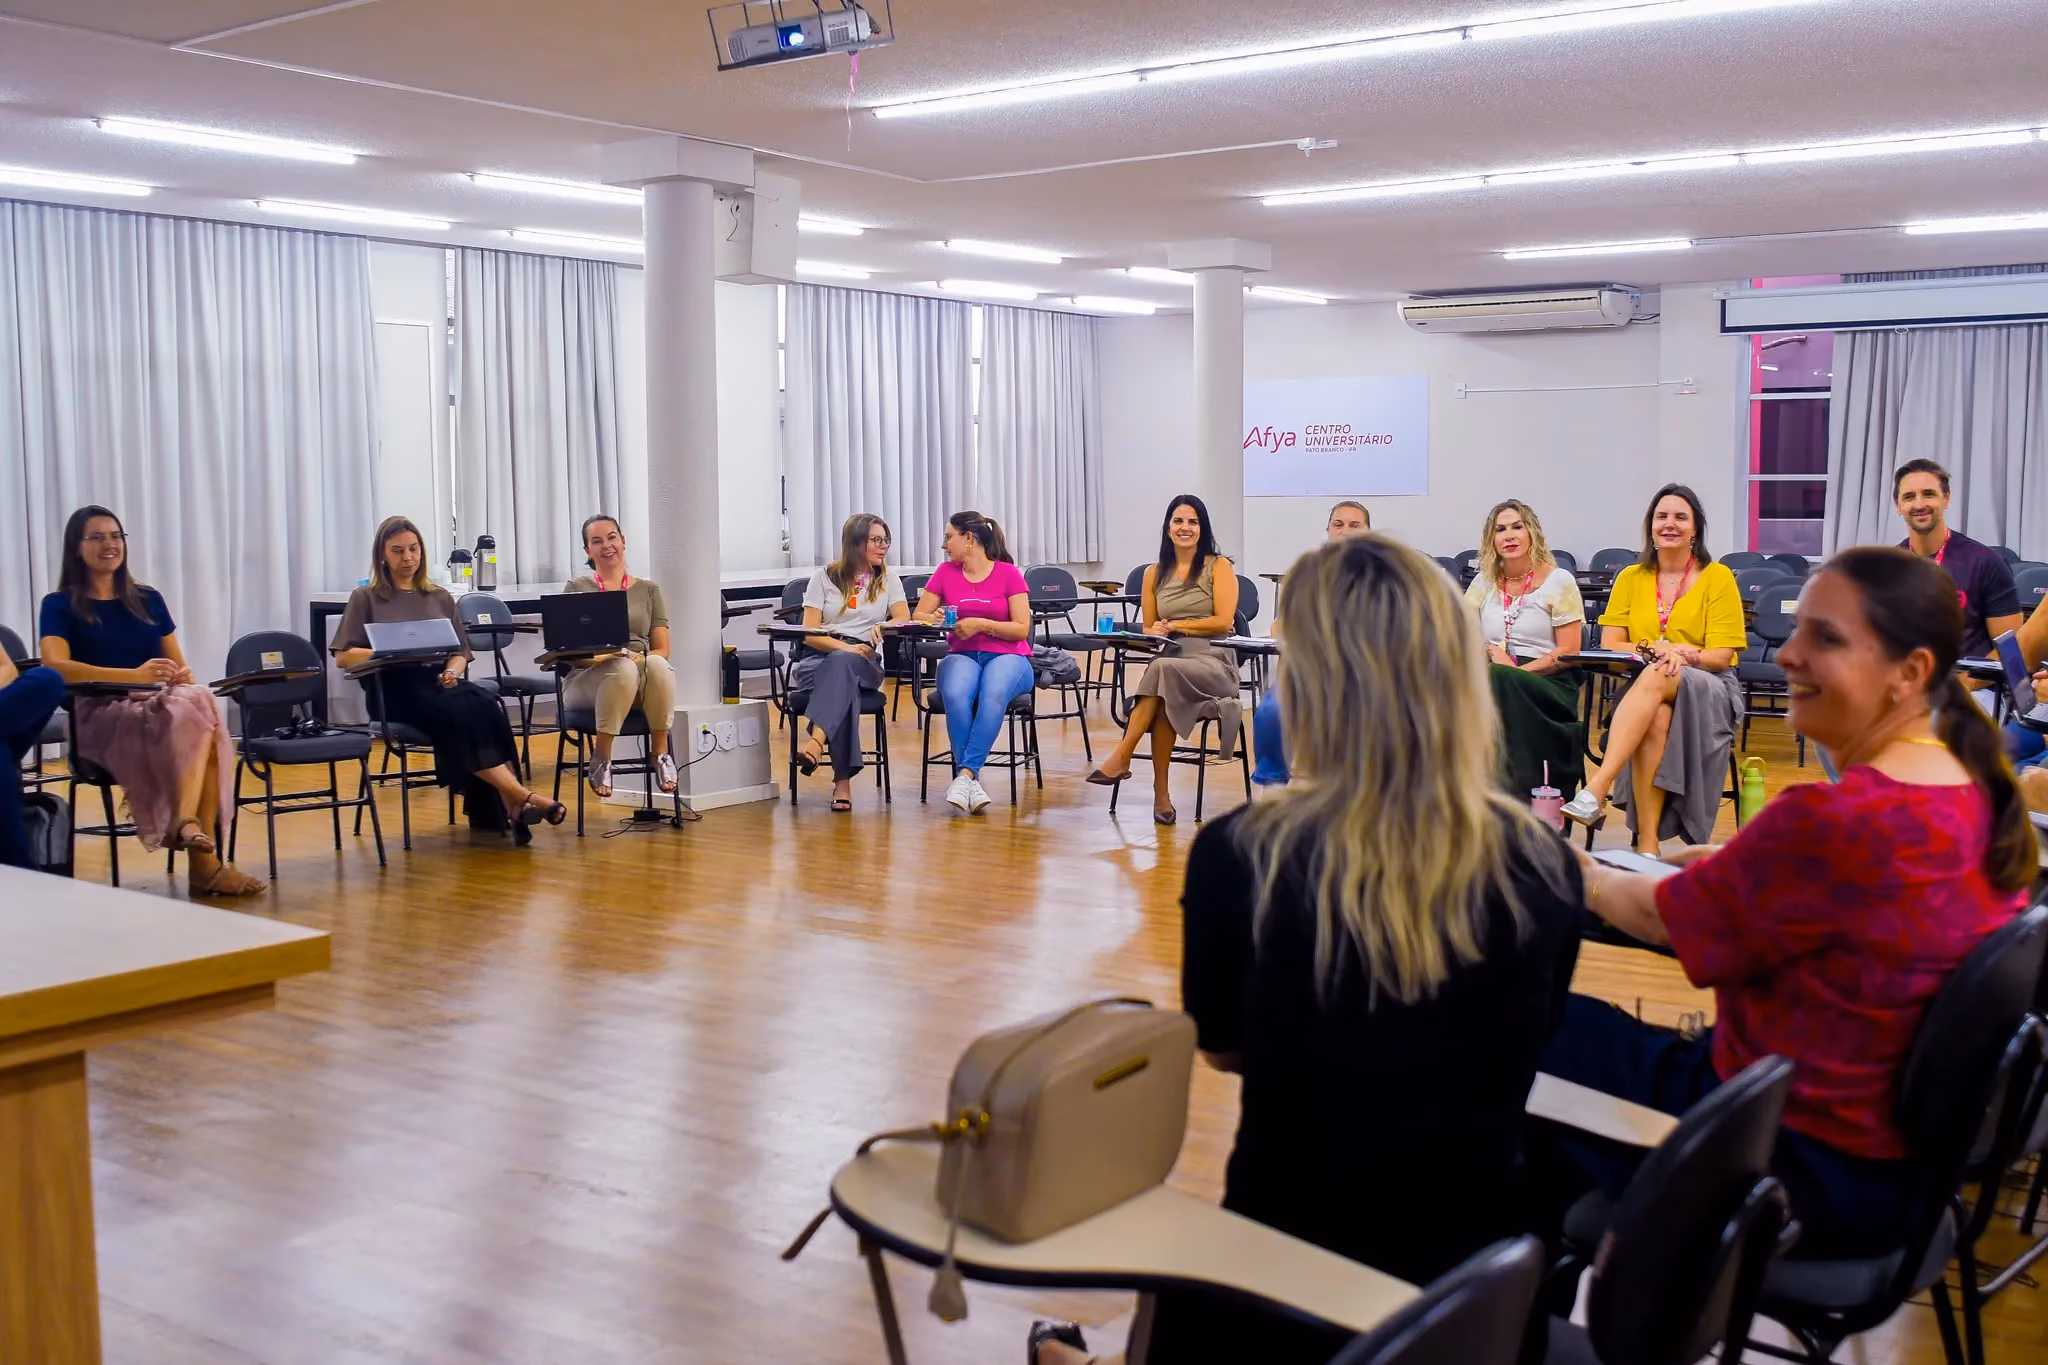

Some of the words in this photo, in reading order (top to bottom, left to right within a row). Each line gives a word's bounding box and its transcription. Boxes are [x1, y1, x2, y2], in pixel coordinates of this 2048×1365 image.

[1305, 424, 1351, 435] CENTRO
[1243, 426, 1297, 454] Afya
[1305, 433, 1393, 447] UNIVERSITÁRIO
